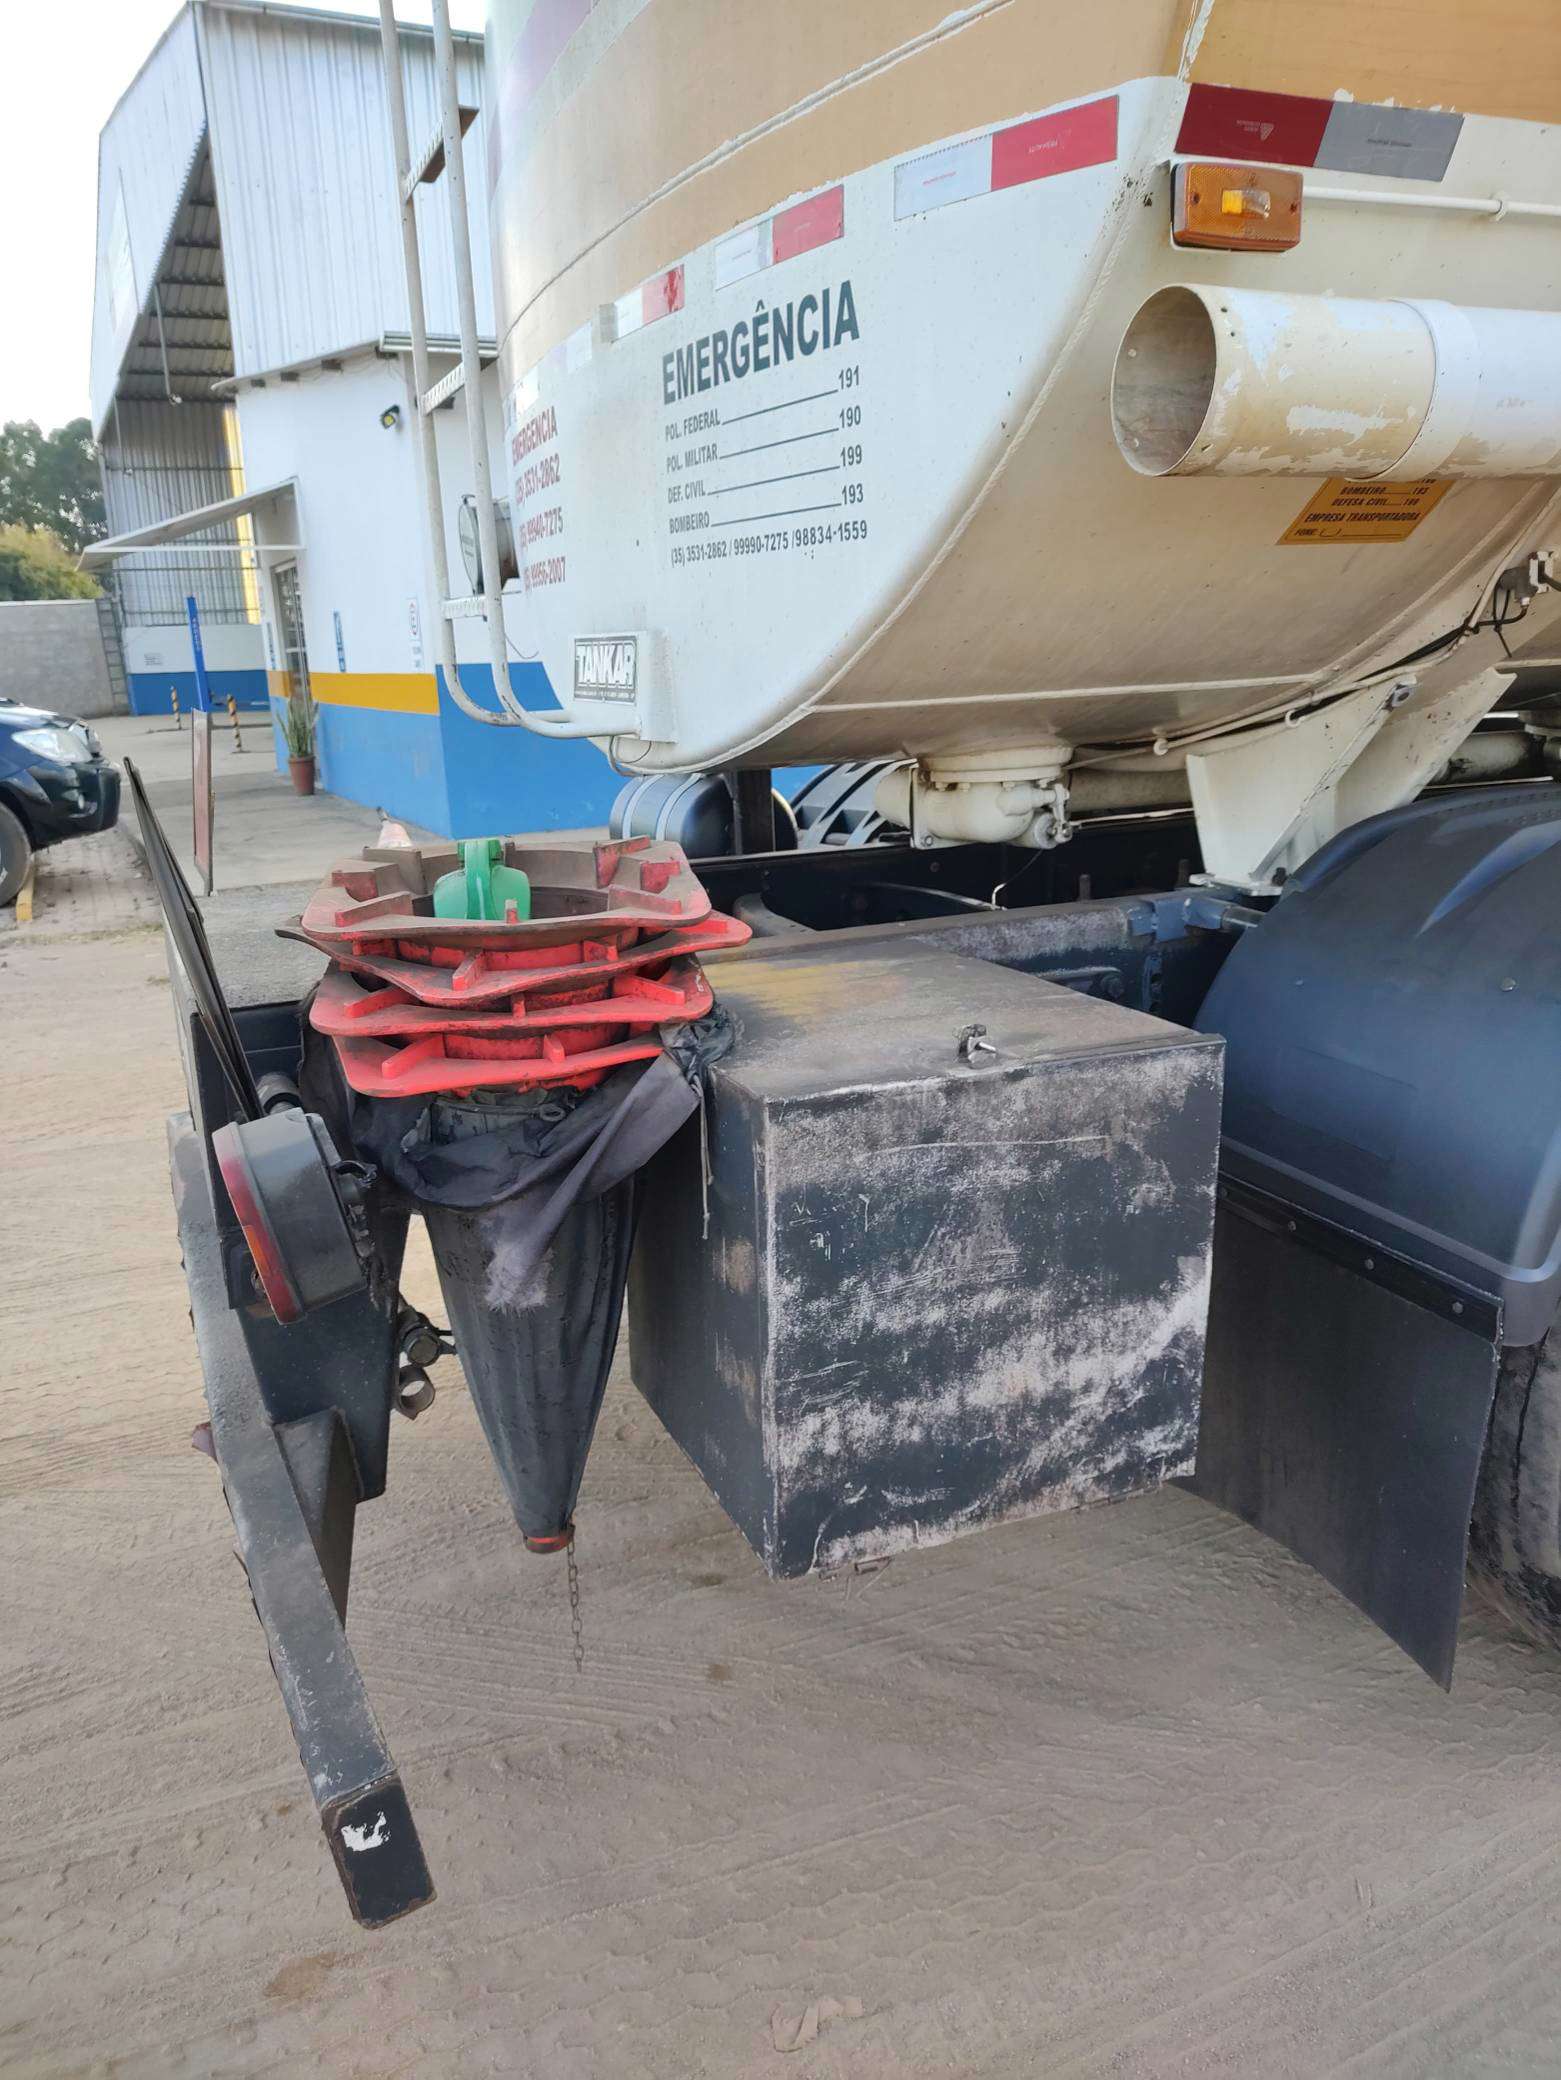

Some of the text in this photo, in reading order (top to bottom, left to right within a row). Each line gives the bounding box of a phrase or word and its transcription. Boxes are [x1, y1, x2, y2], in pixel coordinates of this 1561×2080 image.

[662, 279, 860, 405] EMERGÊNCIA
[665, 365, 861, 441] POL. FEDERAL 191
[666, 405, 862, 473] POL. MILITAR 190
[668, 444, 862, 504] DEF. CIVIL 199
[669, 483, 864, 534] BOMBEIRO 193
[671, 547, 685, 567] (35)
[686, 540, 727, 562] 3531-2862
[733, 531, 789, 555] 99990-7275
